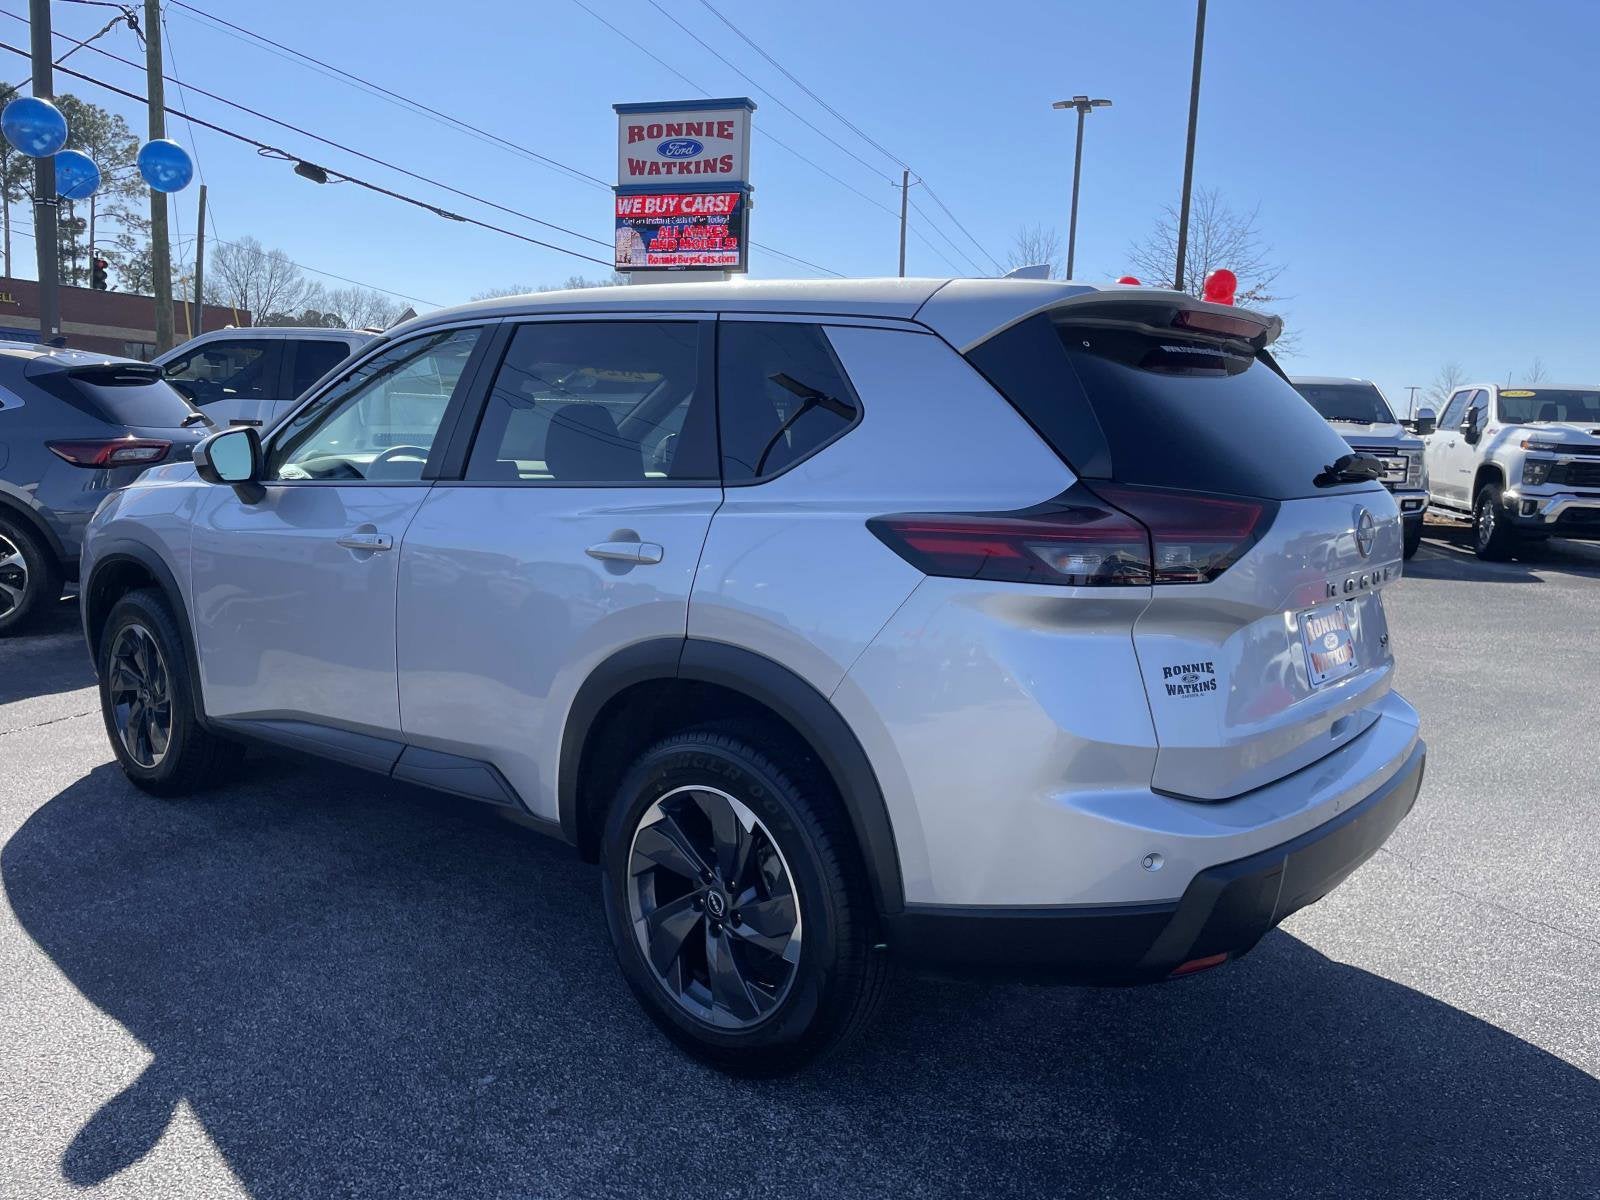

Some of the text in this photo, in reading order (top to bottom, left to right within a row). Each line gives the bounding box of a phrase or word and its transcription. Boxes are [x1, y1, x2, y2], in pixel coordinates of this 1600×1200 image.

[628, 121, 734, 144] RONNIE
[665, 142, 695, 156] Ford
[627, 154, 734, 176] WATKINS
[617, 195, 731, 215] WE BUY CARS!
[657, 225, 682, 238] ALL
[1162, 661, 1215, 680] RONNIE
[1164, 678, 1217, 696] WATKINS
